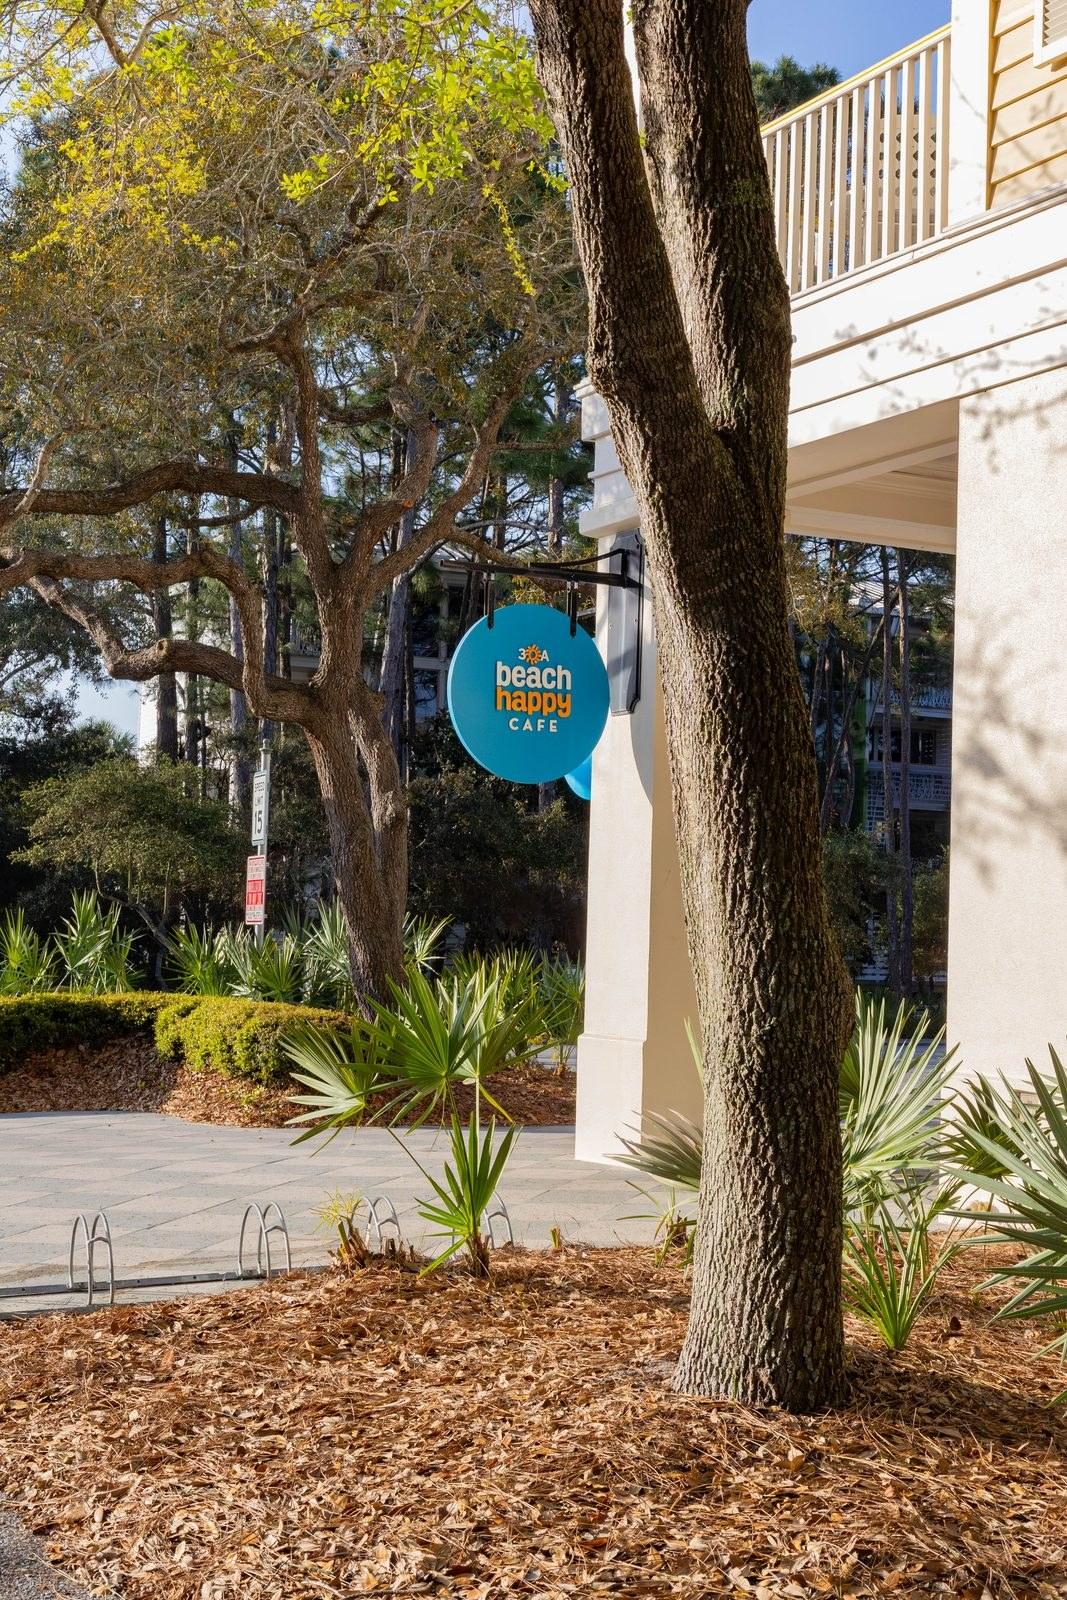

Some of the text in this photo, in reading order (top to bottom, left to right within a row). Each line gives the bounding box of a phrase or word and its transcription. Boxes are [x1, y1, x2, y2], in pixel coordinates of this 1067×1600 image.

[496, 661, 572, 690] beach
[496, 687, 571, 718] happy
[509, 717, 557, 732] CAFE
[255, 810, 263, 834] 15
